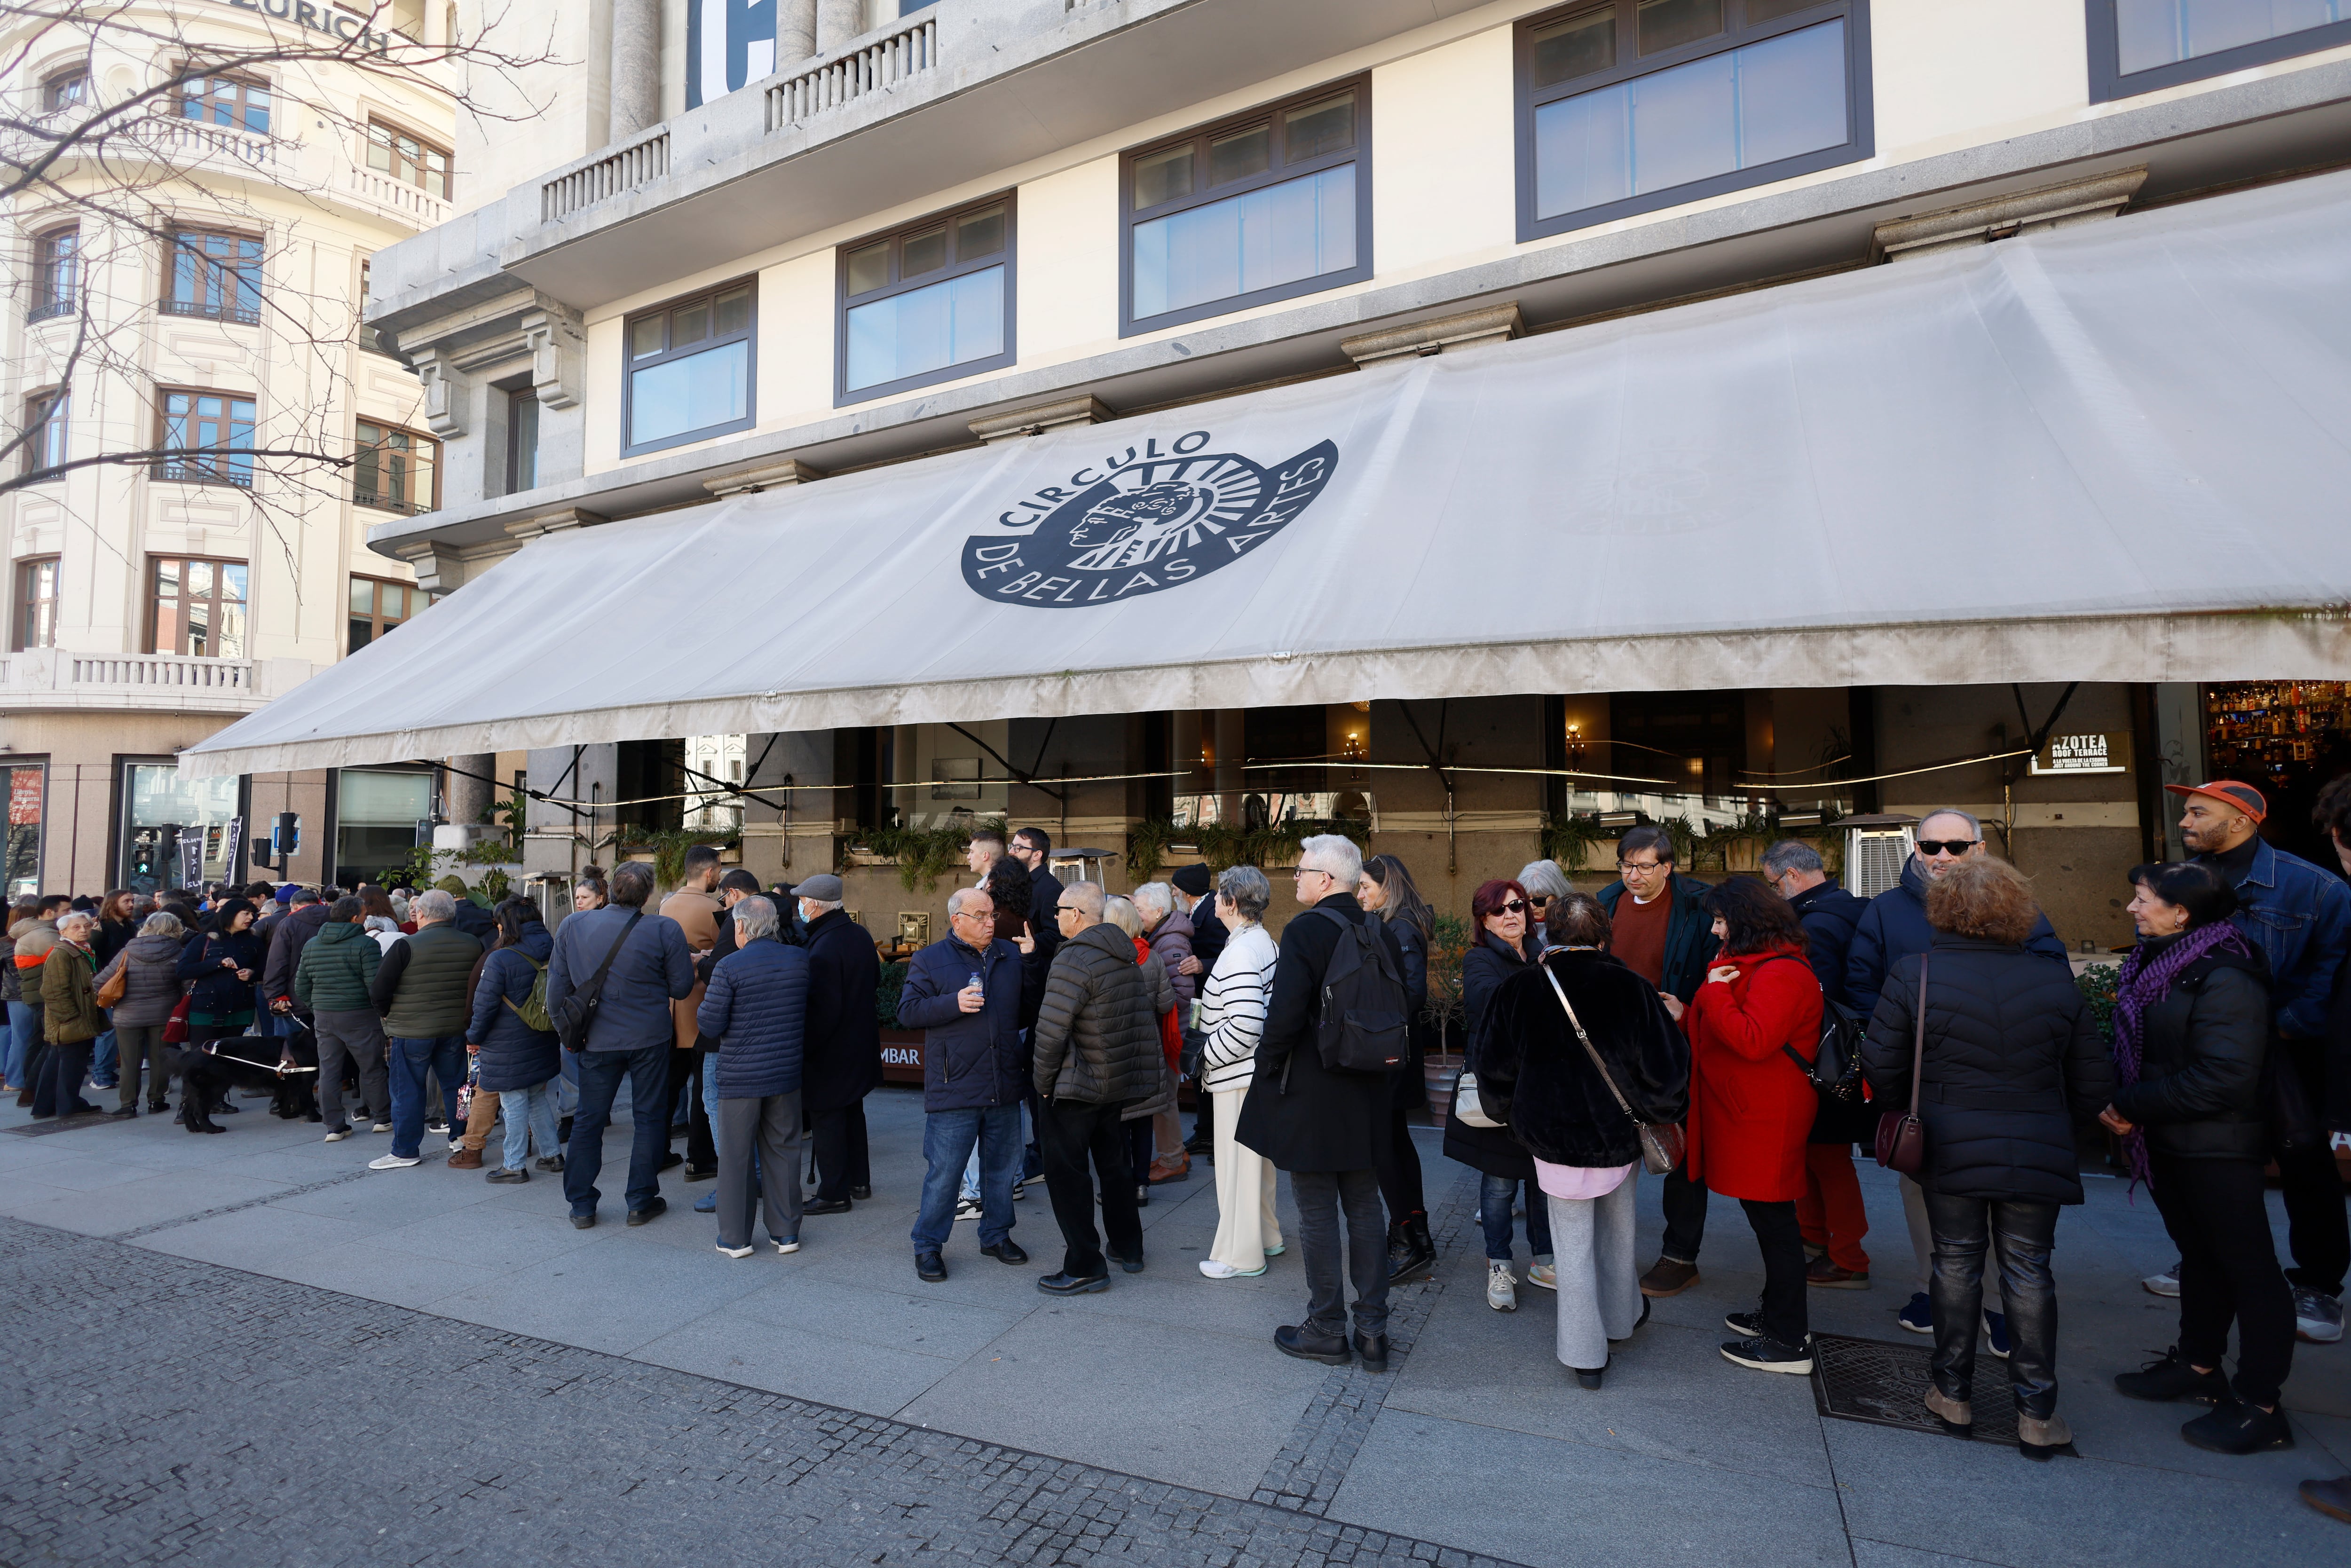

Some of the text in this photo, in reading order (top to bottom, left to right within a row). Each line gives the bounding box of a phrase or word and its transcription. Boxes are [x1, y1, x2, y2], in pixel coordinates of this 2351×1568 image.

[999, 431, 1211, 527] CIRCULO
[975, 457, 1325, 602] DE BELLAS ARTES
[2052, 734, 2107, 750] AZOTEA
[2052, 748, 2107, 757] ROOF TERRACE
[1839, 1349, 1932, 1361] AYUNTAMIEN
[1887, 1381, 1925, 1395] MAD
